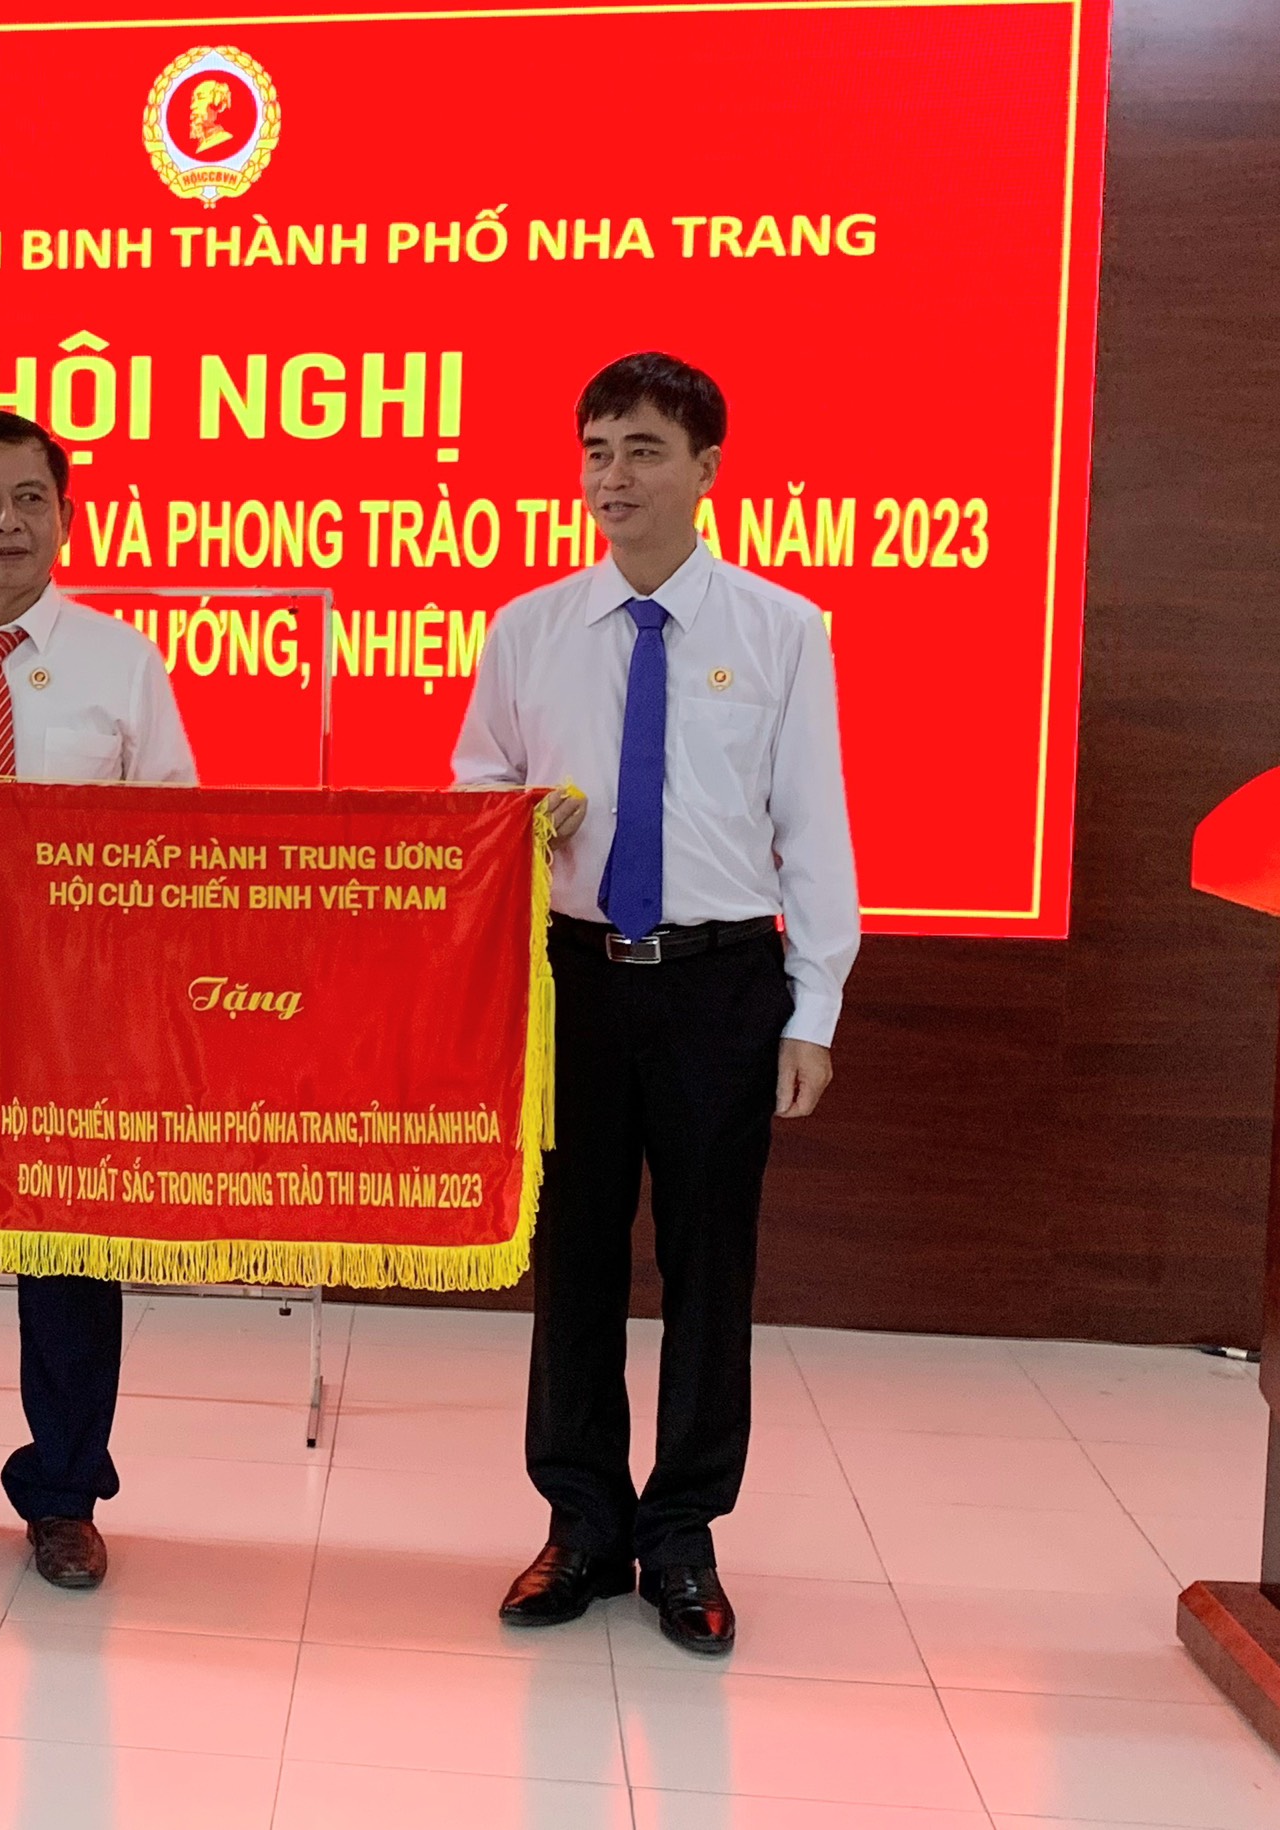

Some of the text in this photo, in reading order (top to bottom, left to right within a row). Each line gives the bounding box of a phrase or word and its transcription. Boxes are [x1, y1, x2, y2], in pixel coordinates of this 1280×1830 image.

[21, 227, 152, 270] BINH
[170, 214, 368, 268] THÀNH
[388, 203, 510, 264] PHỐ
[527, 218, 656, 262] NHA
[671, 212, 878, 259] TRANG
[199, 351, 464, 463] NGHỊ
[85, 484, 153, 568] VÀ
[166, 499, 345, 569] PHONG
[359, 482, 501, 569] TRÀO
[516, 498, 597, 568] THI
[738, 481, 856, 568] NĂM
[871, 497, 990, 569] 2023
[331, 601, 487, 696] NHIỆM
[35, 834, 464, 870] BAN CHẤP HÀNH TRUNG ƯƠNG
[49, 874, 447, 917] HỘI CỰU CHIẾN BINH VIỆT NAM
[187, 976, 305, 1021] Tặng
[1, 1096, 28, 1142] HỘI
[31, 1101, 65, 1143] CỰU
[67, 1097, 116, 1141] CHIẾN
[119, 1110, 159, 1143] BINH
[161, 1104, 221, 1143] THÀNH
[224, 1100, 265, 1144] PHỐ
[263, 1111, 299, 1144] NHA
[403, 1103, 463, 1145] KHÁNH
[464, 1102, 502, 1144] HÒA
[17, 1154, 484, 1209] ĐƠN VỊ XUẤT SẮC TRONG PHONG TRÀO THI ĐUA NĂM 2023
